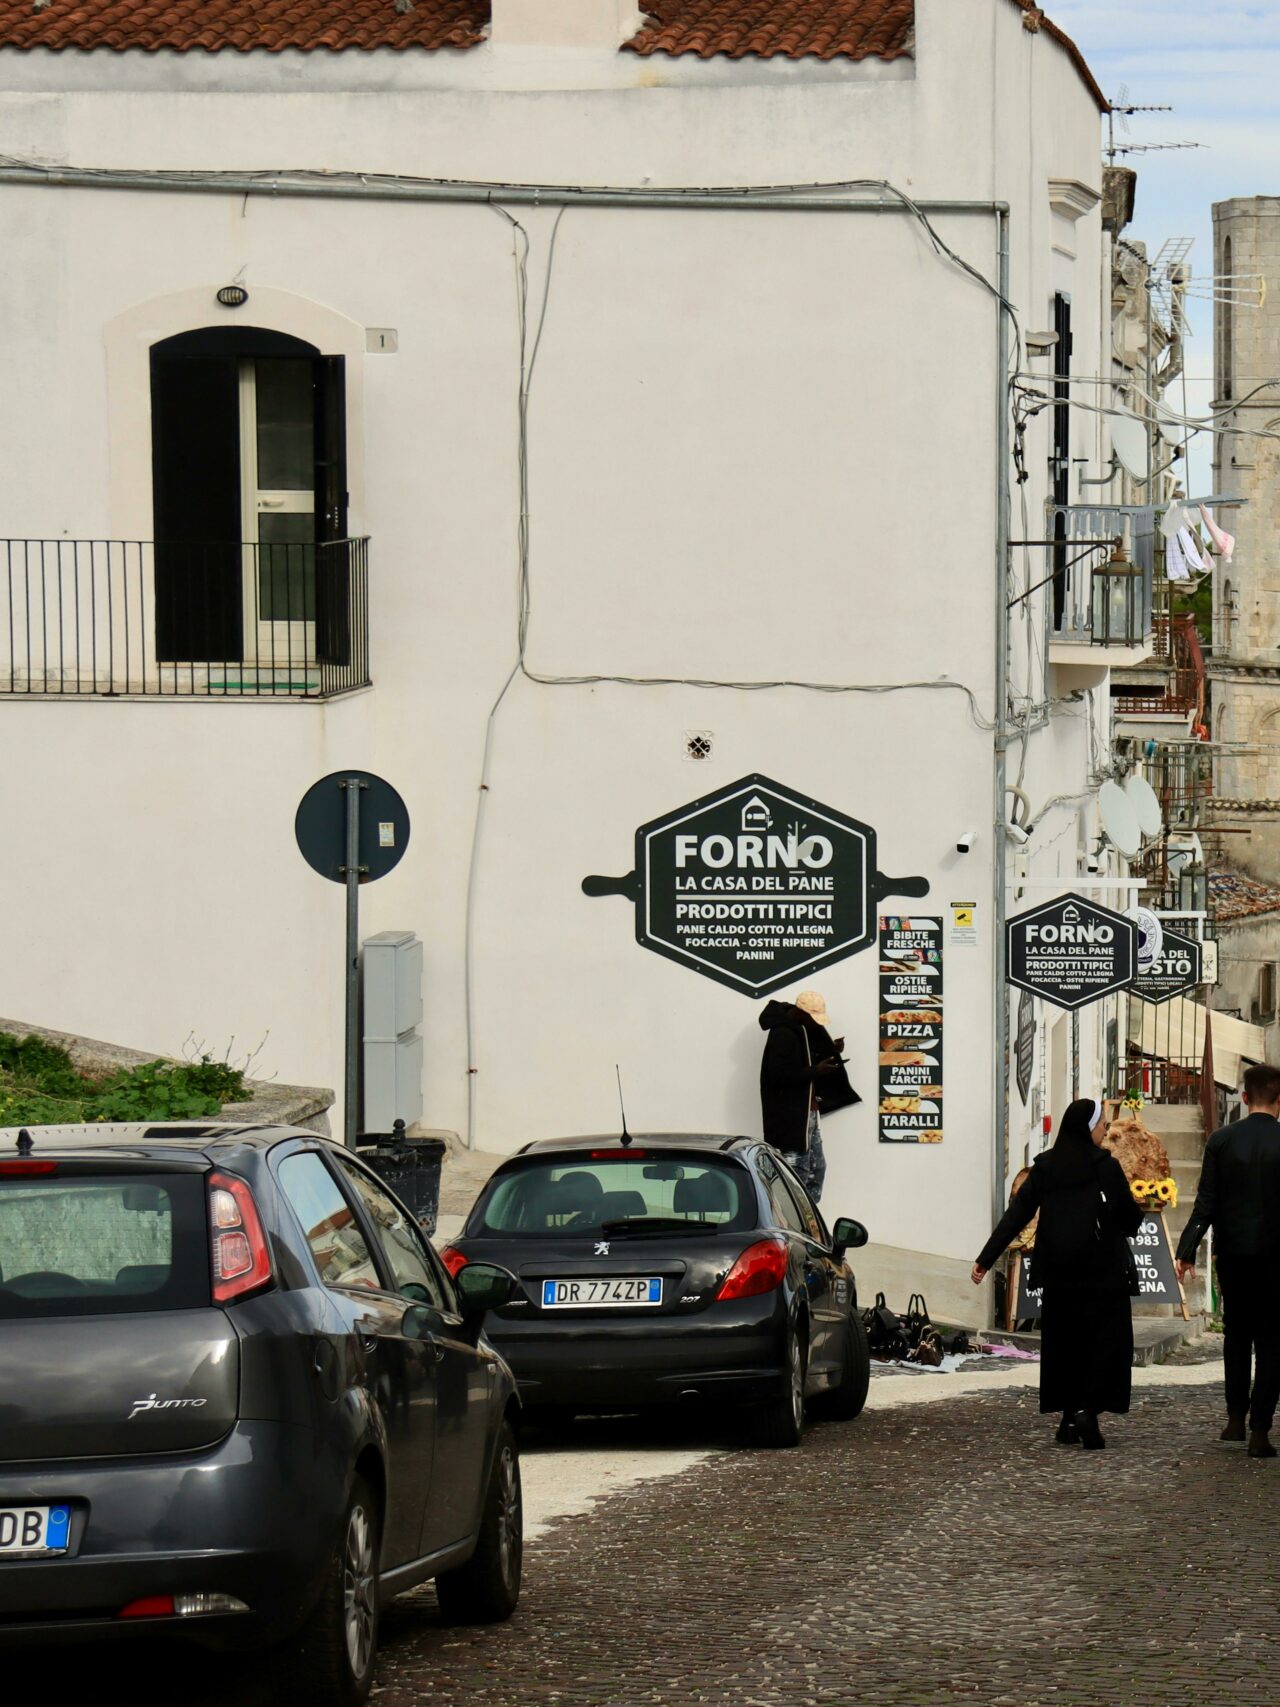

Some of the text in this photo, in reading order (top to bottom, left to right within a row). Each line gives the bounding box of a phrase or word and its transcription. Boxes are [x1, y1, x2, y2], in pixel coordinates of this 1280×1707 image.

[676, 834, 834, 869] FORNO
[676, 876, 834, 890] LA CASA DEL PANE
[676, 904, 832, 919] PRODOTTI TIPICI
[677, 925, 834, 934] PANE CALDO COTTO A LEGNA
[1025, 924, 1114, 944] FORNO
[894, 931, 928, 939] BIBITE
[685, 938, 740, 947] FOCACCIA
[749, 938, 780, 947] OSTIE
[783, 938, 825, 947] RIPIENE
[887, 940, 935, 948] FRESCHE
[736, 951, 774, 960] PANINI
[1025, 947, 1114, 955] LA CASA DEL PANE
[1169, 950, 1190, 959] DEL
[1026, 961, 1113, 970] PRODOTTI TIPICI
[1140, 959, 1191, 974] STO
[895, 976, 927, 985] OSTIE
[890, 985, 932, 993] RIPIENE
[887, 1024, 934, 1036] PIZZA
[892, 1067, 930, 1075] PANINI
[890, 1076, 932, 1084] FARCITI
[882, 1115, 938, 1126] TARALLI
[557, 1281, 648, 1302] DR 774ZP
[680, 1296, 701, 1304] 207
